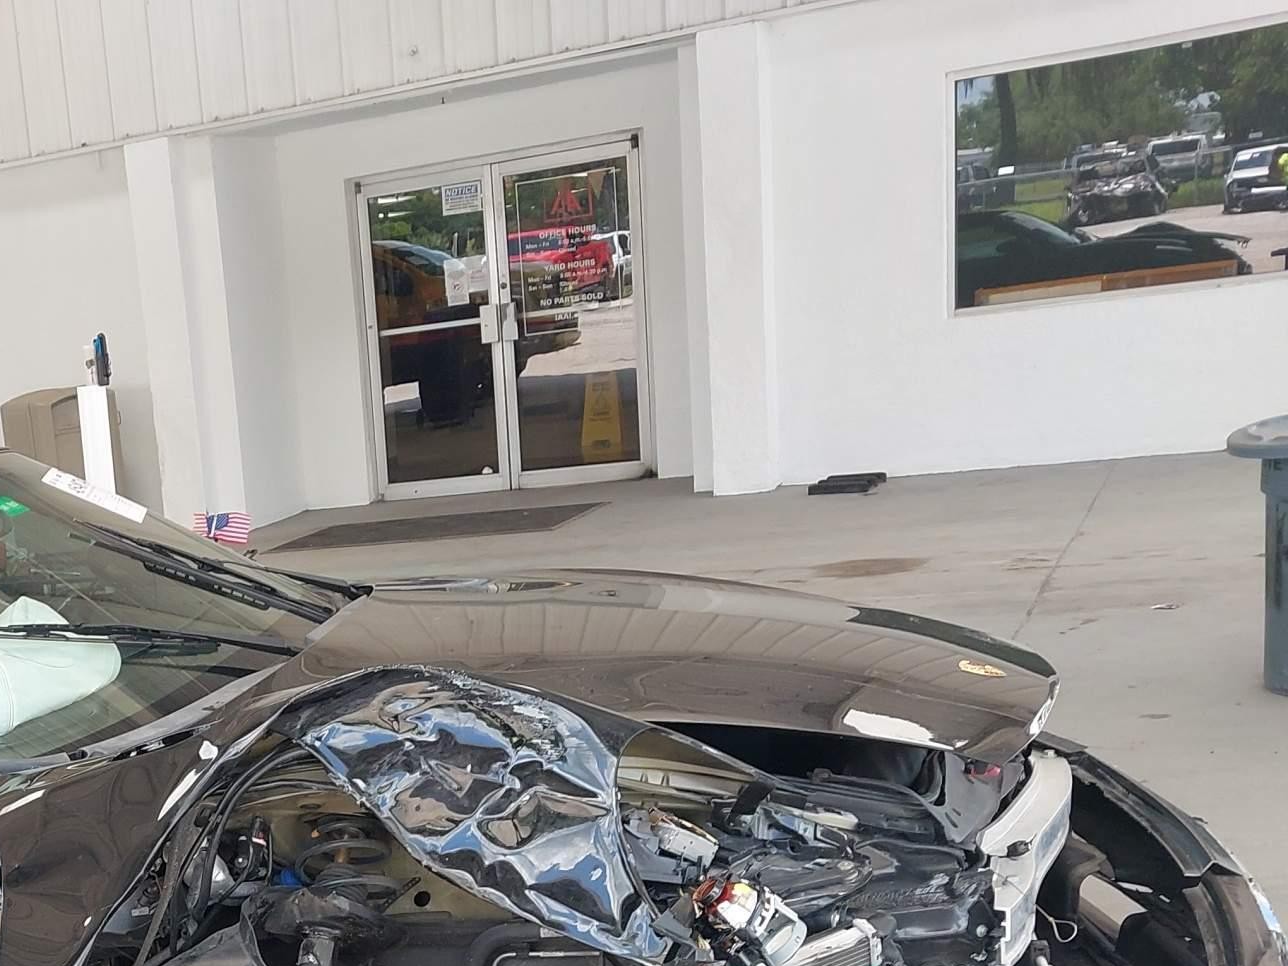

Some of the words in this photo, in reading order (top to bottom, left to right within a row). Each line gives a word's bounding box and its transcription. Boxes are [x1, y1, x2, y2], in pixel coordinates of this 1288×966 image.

[445, 185, 477, 197] NOTICE
[539, 228, 567, 240] OFFICE
[568, 224, 597, 235] HOURS
[544, 262, 566, 272] YARD
[567, 258, 596, 269] HOURS
[540, 298, 552, 307] NO
[554, 295, 579, 305] PARTS
[581, 292, 604, 301] SOLD
